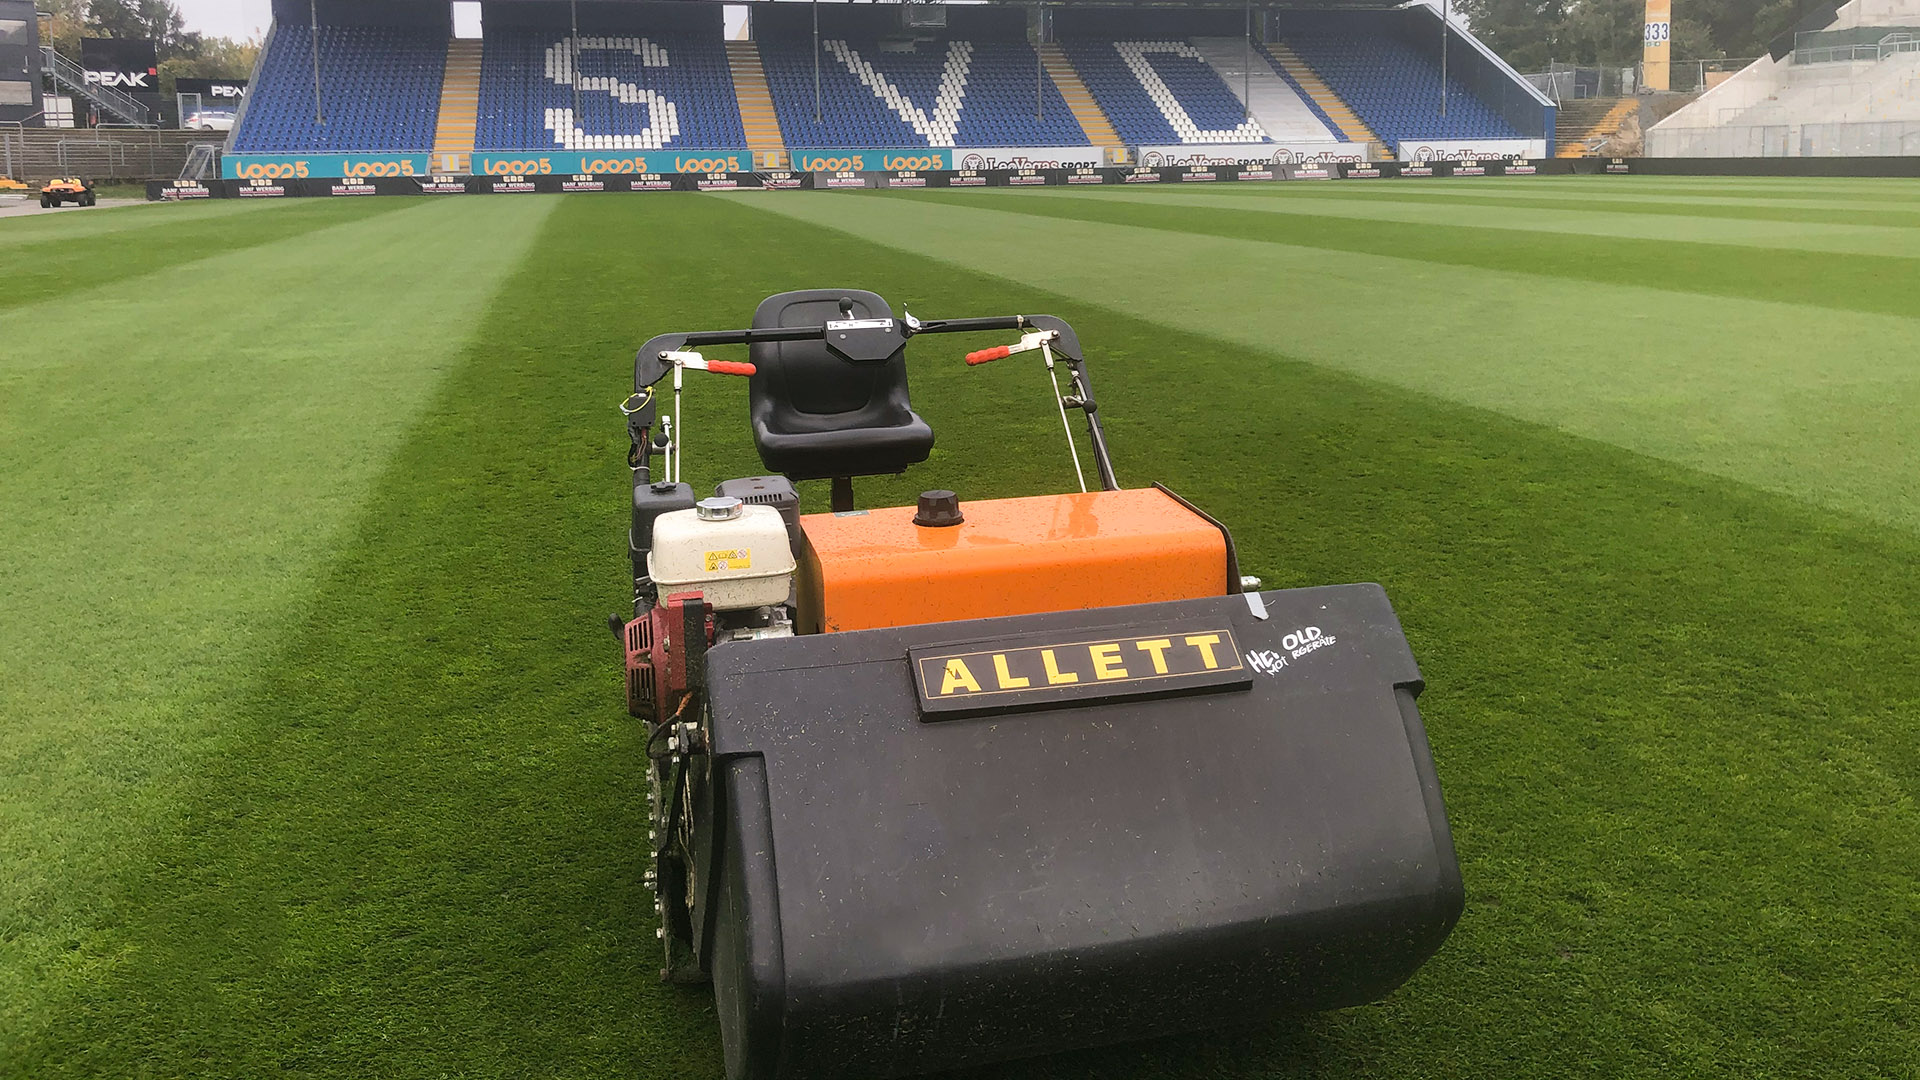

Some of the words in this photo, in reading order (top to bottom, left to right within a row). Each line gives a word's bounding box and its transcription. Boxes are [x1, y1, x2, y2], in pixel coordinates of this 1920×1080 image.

[1645, 23, 1669, 40] 333
[84, 71, 149, 87] PEAK
[211, 86, 248, 97] PEA
[766, 153, 776, 167] 2
[1115, 149, 1124, 163] 3
[940, 634, 1220, 695] ALLETT
